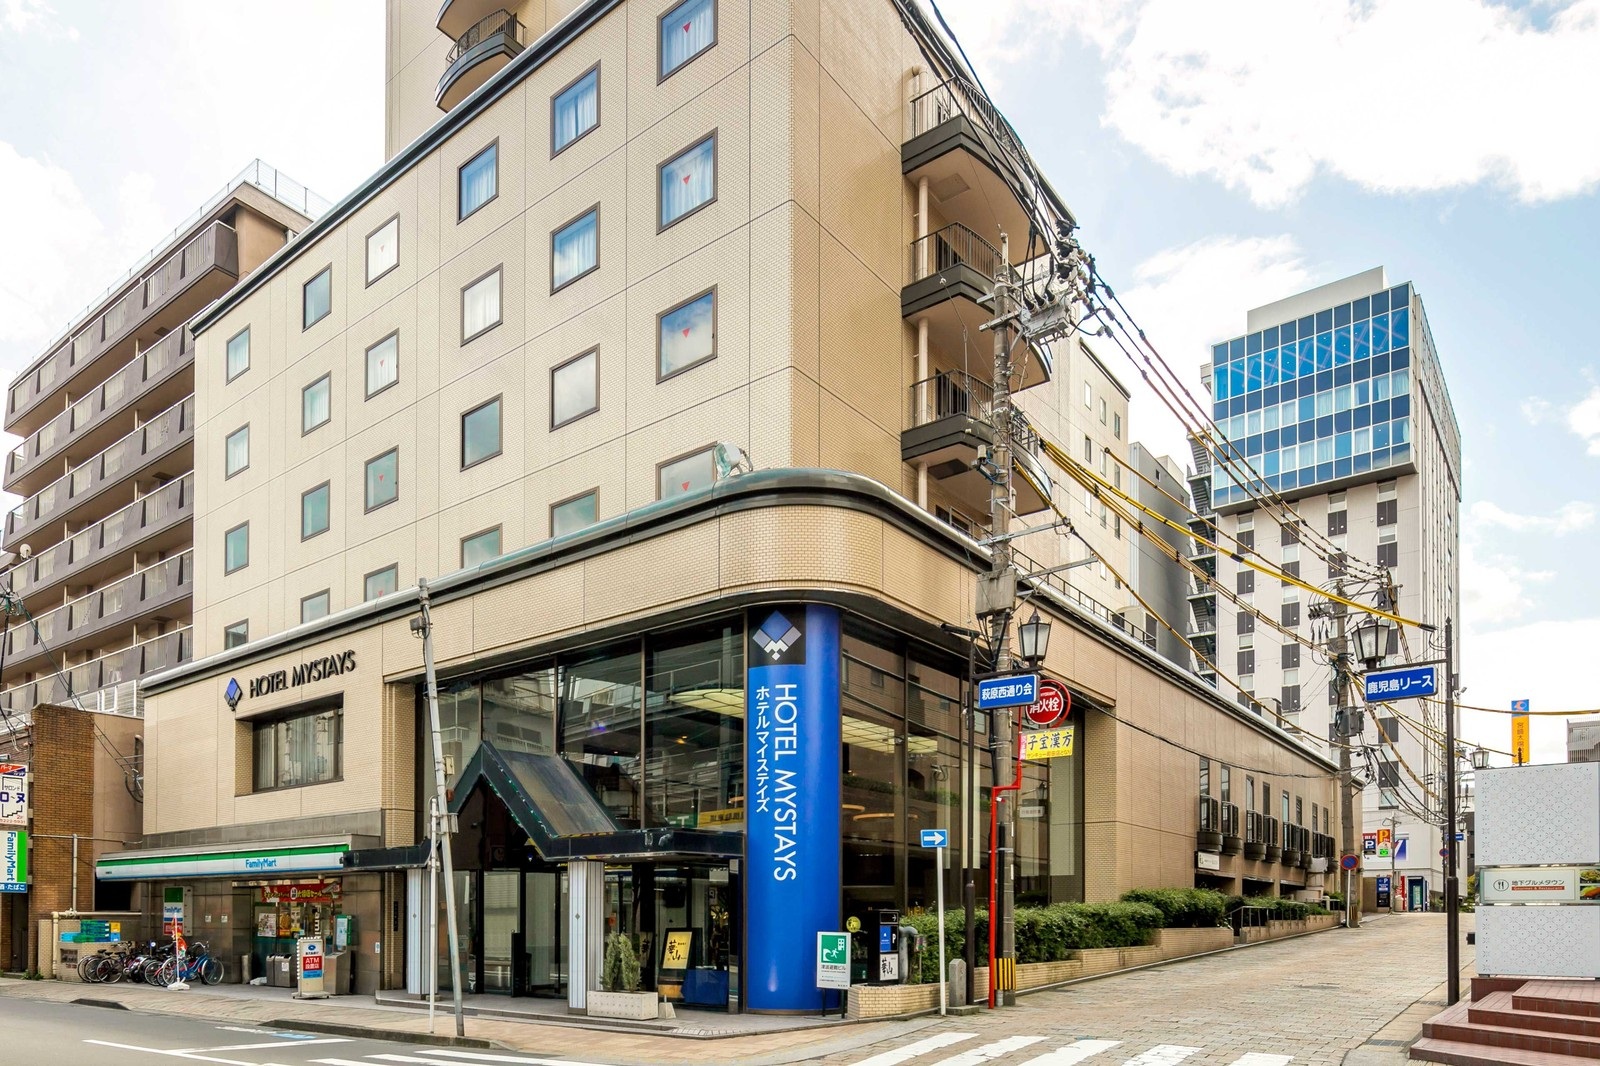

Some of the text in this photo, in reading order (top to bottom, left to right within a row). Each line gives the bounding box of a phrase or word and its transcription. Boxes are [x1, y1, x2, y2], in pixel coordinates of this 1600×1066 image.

[249, 649, 356, 699] HOTEL MYSTAYS
[1367, 674, 1433, 695] 鹿児島リース
[1029, 696, 1060, 715] 消火栓
[755, 685, 771, 813] ホテルマイステイズ
[1028, 731, 1073, 750] 子宝漢方
[773, 683, 798, 881] HOTEL MYSTAYS
[4, 831, 17, 882] FamilyMart
[245, 858, 277, 870] FamilyMart
